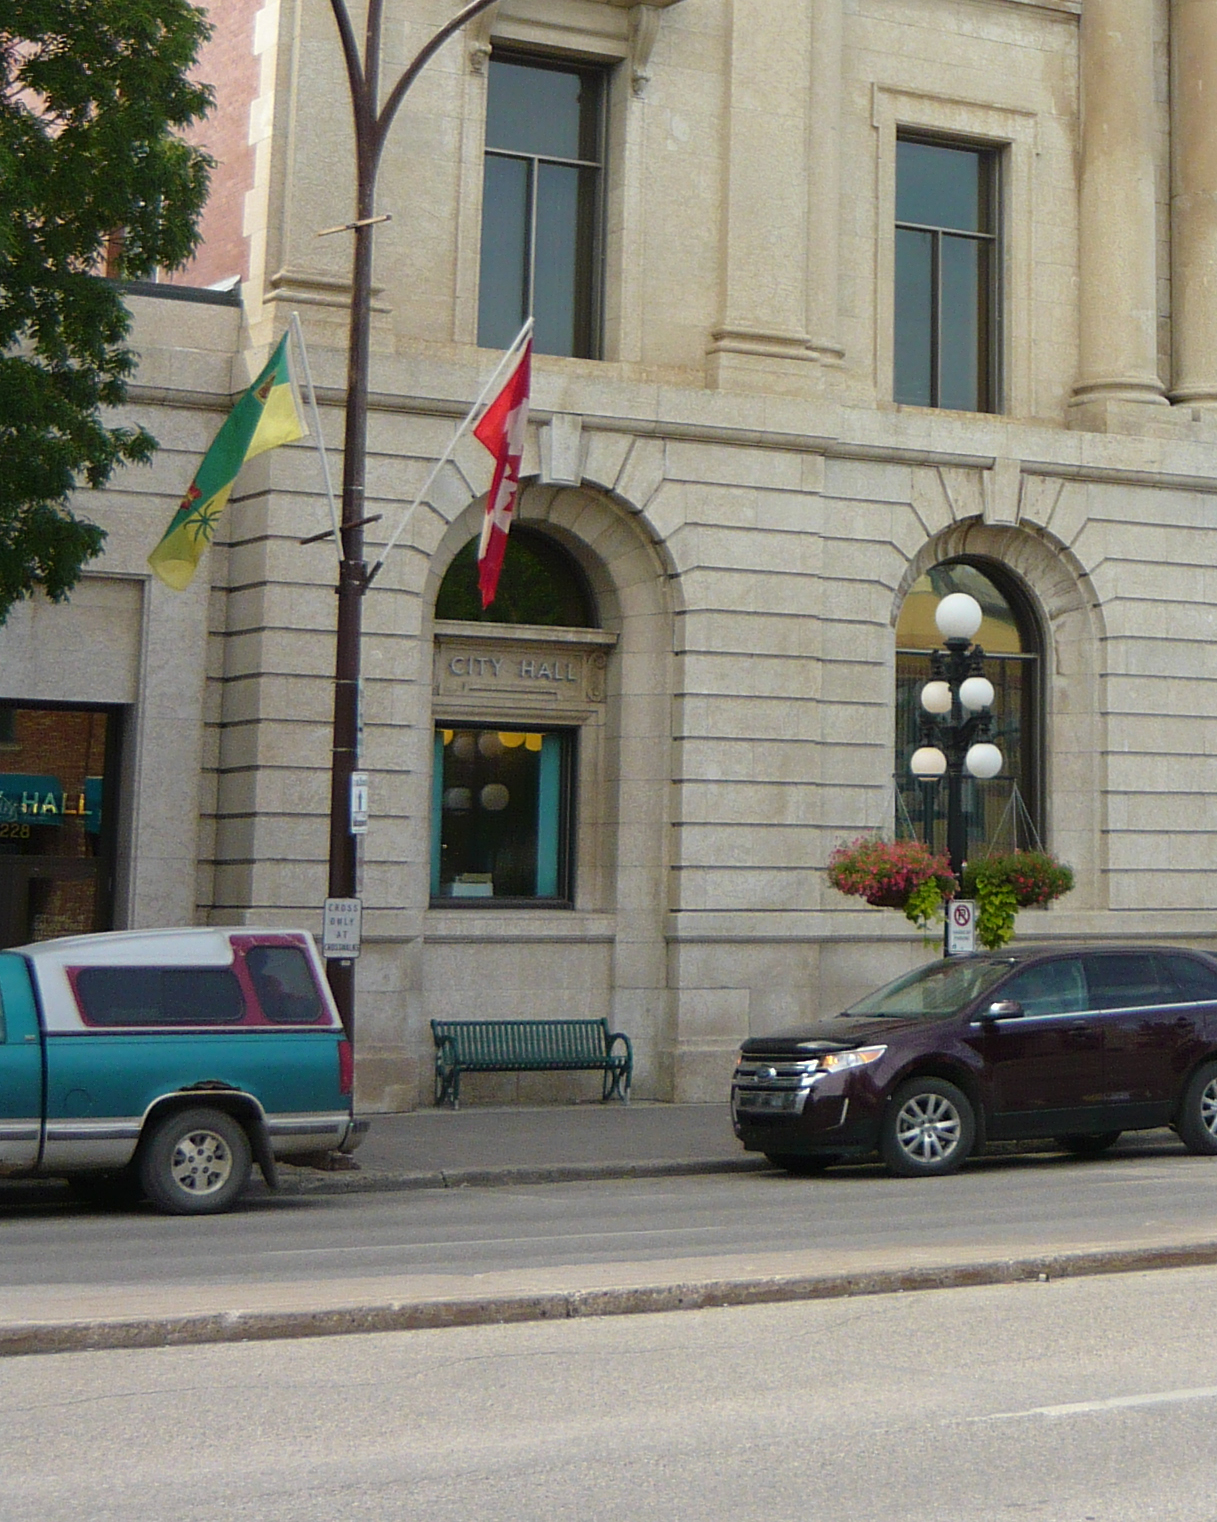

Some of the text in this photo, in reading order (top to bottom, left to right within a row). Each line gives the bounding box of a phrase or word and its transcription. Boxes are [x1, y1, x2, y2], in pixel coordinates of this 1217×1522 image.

[449, 656, 578, 682] CITY HALL
[21, 791, 94, 815] HALL
[0, 823, 31, 838] 228
[328, 903, 359, 913] CROSS
[330, 917, 355, 926] ONLY
[336, 930, 349, 939] AT
